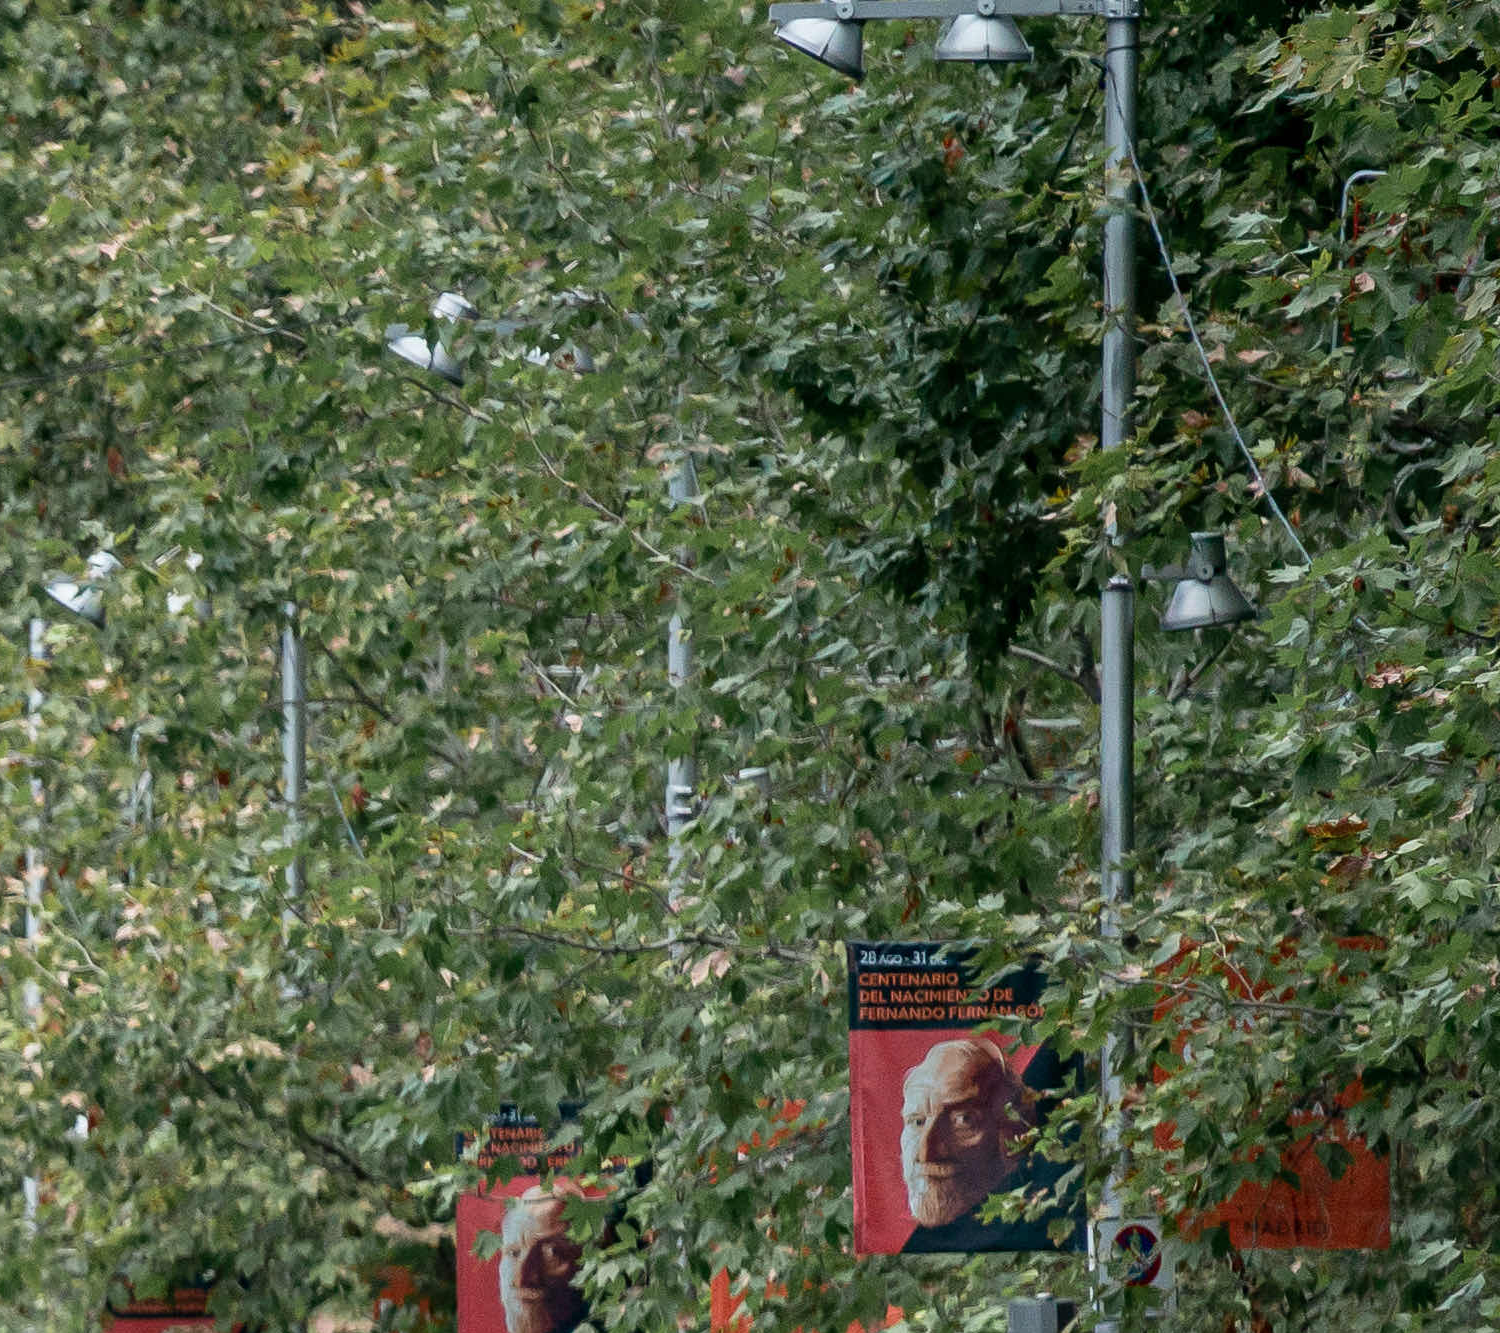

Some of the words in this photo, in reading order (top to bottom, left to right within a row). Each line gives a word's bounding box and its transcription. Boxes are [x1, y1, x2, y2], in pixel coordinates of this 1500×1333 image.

[912, 949, 927, 966] 31
[858, 972, 959, 988] CENTENARIO
[858, 988, 887, 1004] DEL
[993, 987, 1013, 1003] DE
[858, 1006, 946, 1022] FERNANDO
